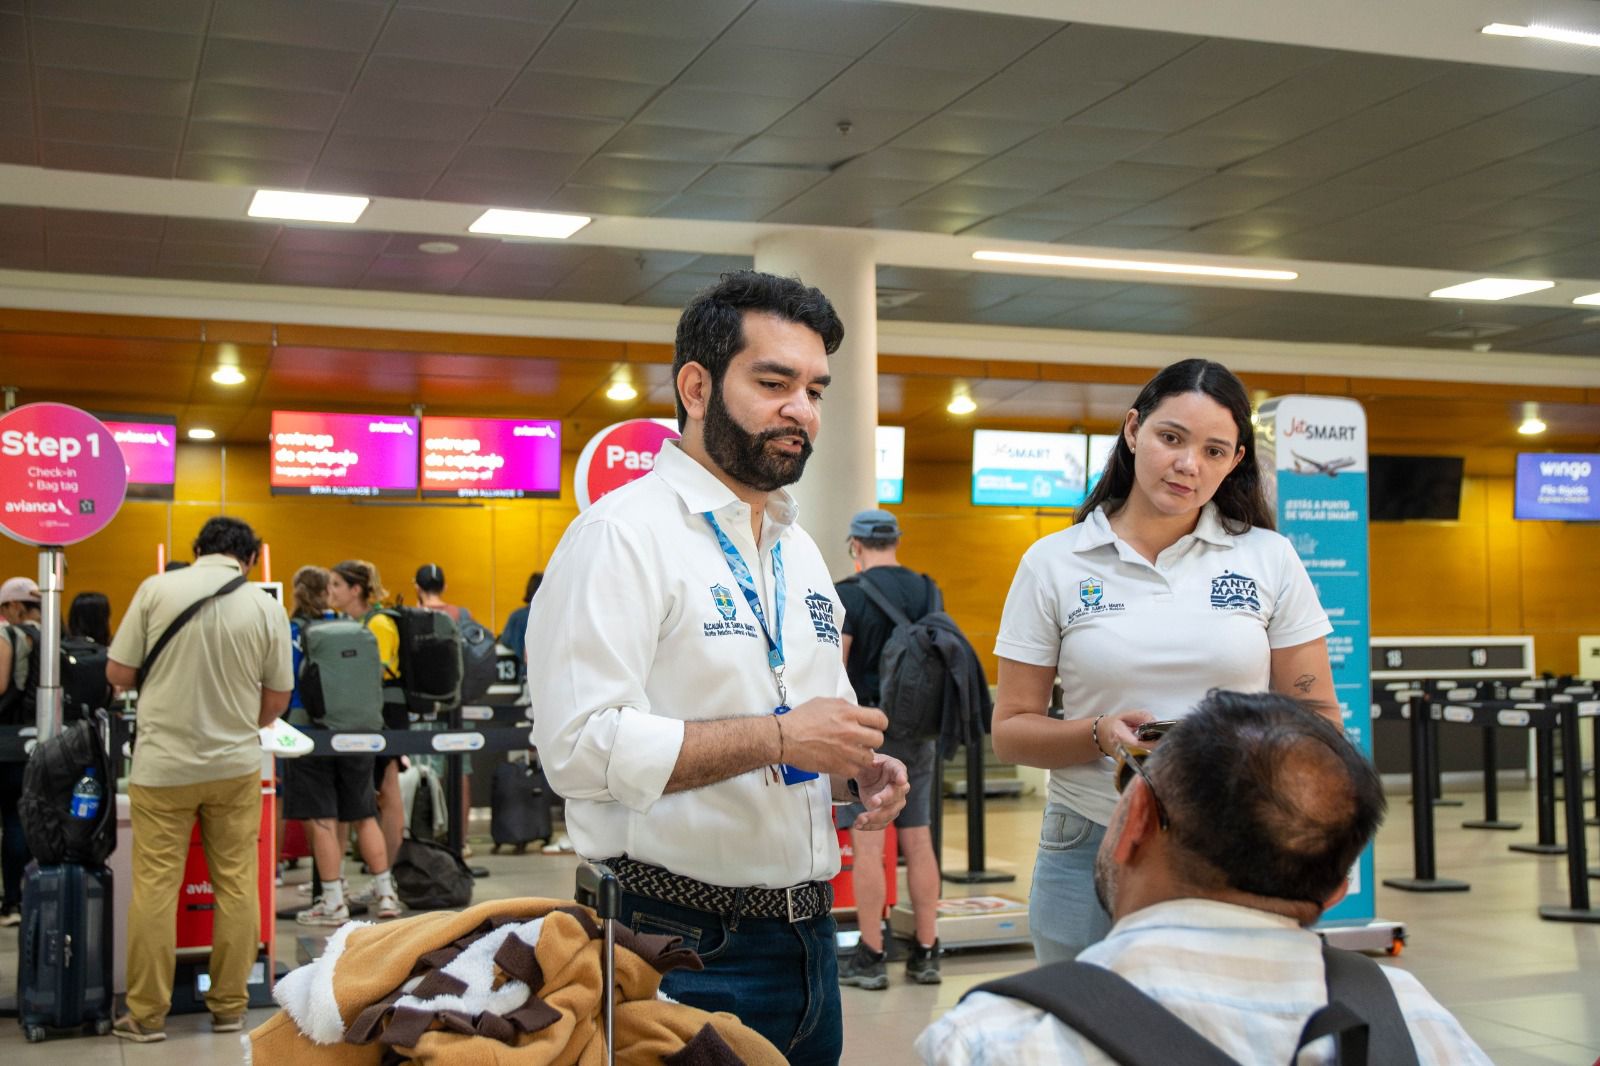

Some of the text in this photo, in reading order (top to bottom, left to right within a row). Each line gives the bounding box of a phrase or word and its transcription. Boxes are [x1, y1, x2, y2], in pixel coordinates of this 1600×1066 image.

[2, 430, 100, 463] Step 1
[606, 445, 655, 470] Pas
[27, 466, 77, 478] Check-in
[1540, 461, 1592, 481] wingo
[37, 479, 59, 493] Bag
[60, 481, 79, 493] tag
[5, 499, 56, 513] avianca
[1211, 579, 1257, 591] SANTA
[1211, 586, 1258, 599] MARTA
[804, 599, 834, 615] SANTA
[810, 609, 834, 624] MARTA
[496, 660, 516, 680] 13
[186, 880, 214, 895] avia
